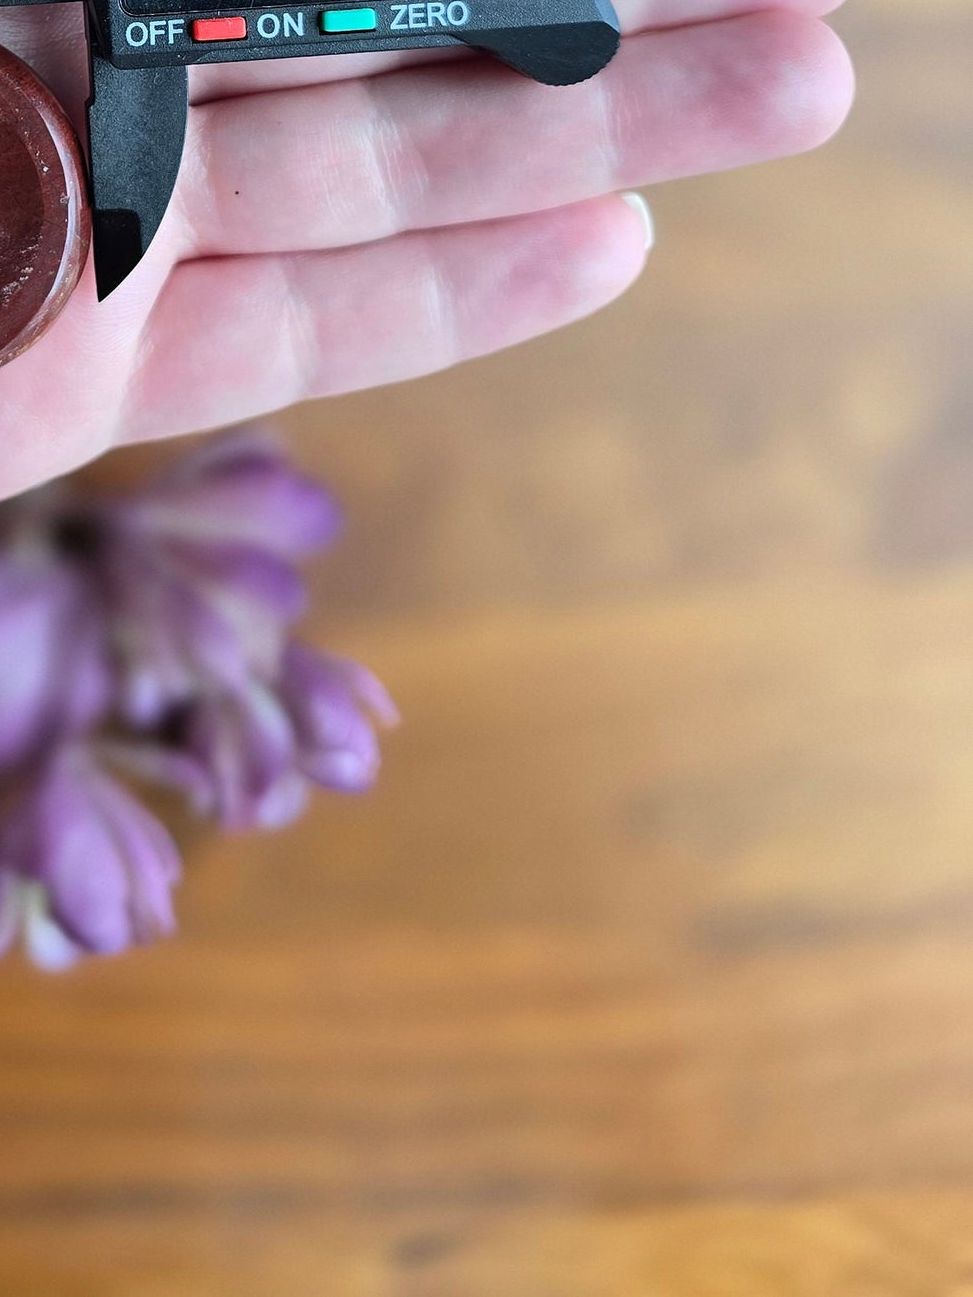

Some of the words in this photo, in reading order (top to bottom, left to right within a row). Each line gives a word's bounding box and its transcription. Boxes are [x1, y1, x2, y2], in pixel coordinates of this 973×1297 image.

[125, 18, 185, 48] OFF
[257, 12, 305, 38] ON
[390, 1, 469, 31] ZERO
